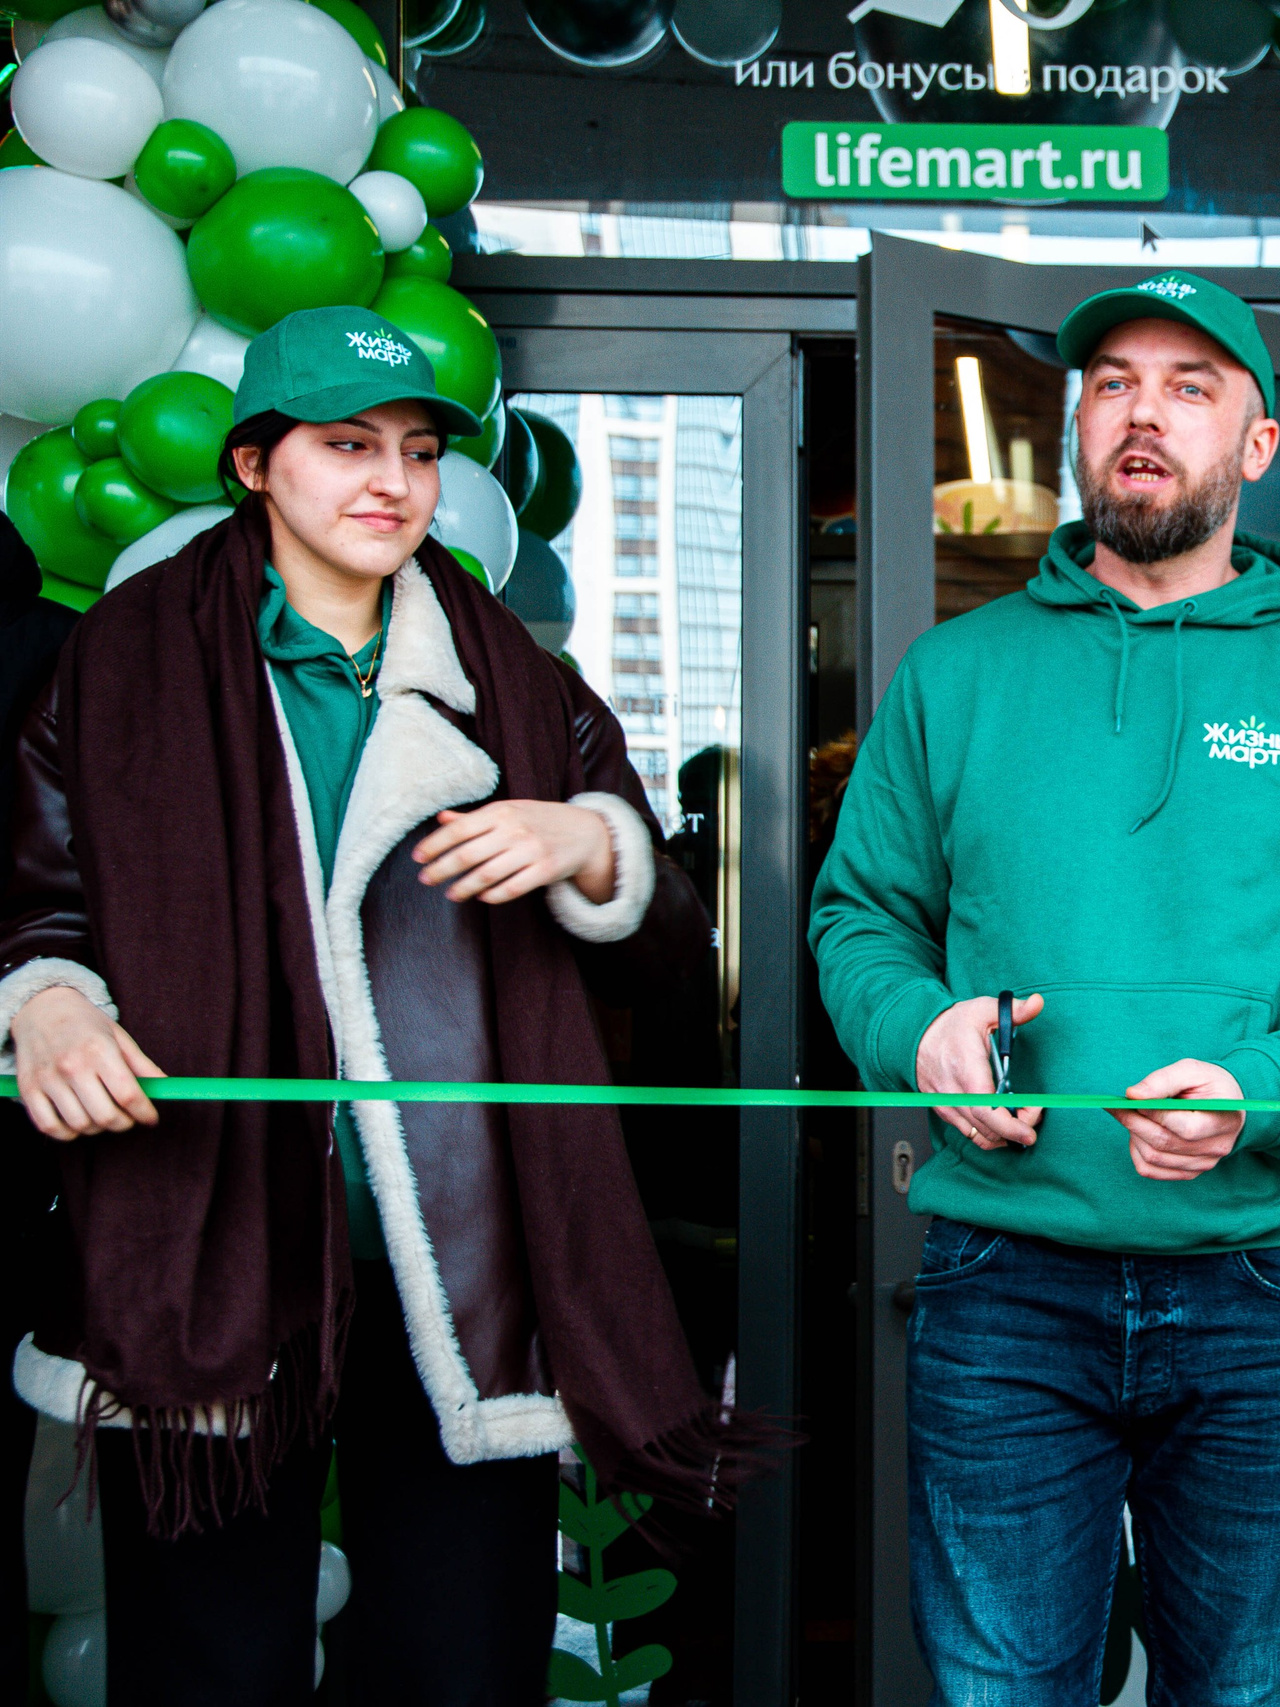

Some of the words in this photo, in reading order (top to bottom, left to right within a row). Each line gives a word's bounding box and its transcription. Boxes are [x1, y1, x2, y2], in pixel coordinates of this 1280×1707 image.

[735, 60, 815, 88] или
[828, 51, 996, 101] бонусы
[1042, 63, 1230, 104] подарок
[814, 131, 1143, 190] lifemart.ru
[345, 331, 413, 357] Жизнь
[358, 347, 411, 367] март
